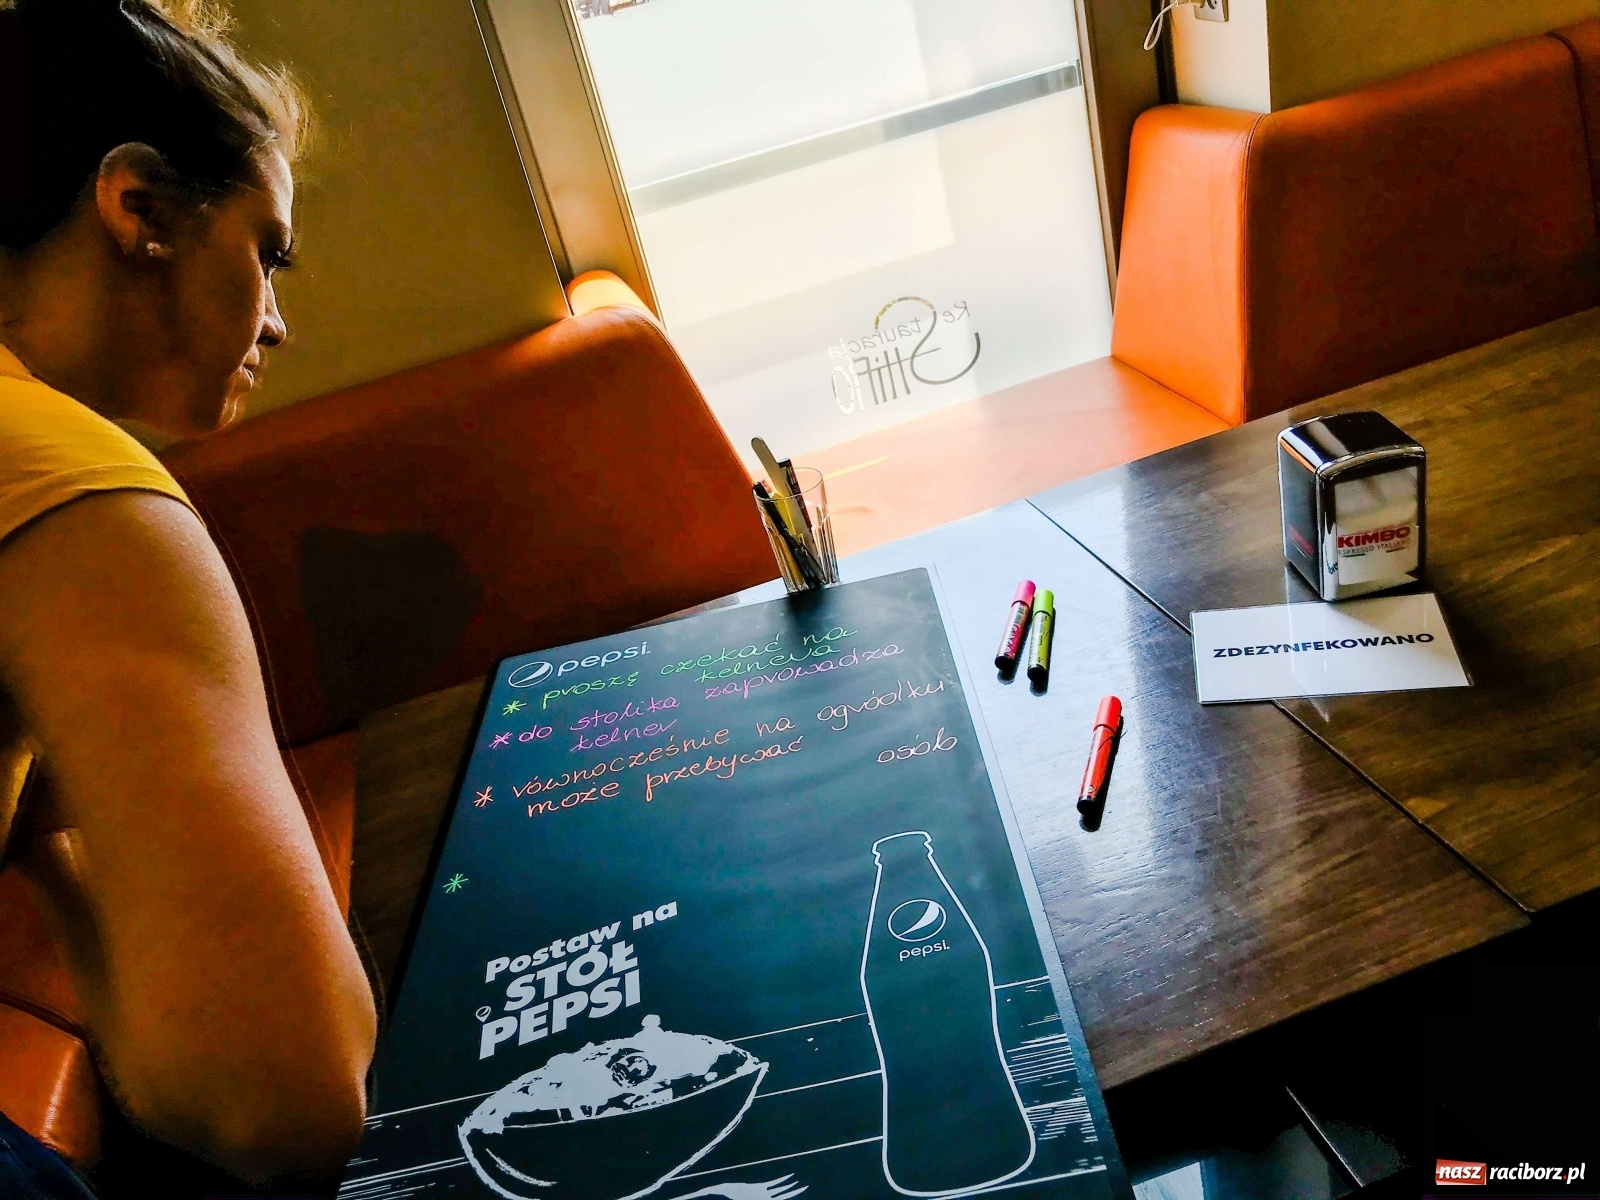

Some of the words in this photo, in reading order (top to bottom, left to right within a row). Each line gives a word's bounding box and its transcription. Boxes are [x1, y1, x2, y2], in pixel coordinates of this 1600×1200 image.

[1337, 526, 1411, 549] KIMBO
[1338, 545, 1375, 556] ESPRESSO
[1377, 538, 1412, 552] ITALIANO
[660, 633, 783, 676] czekać
[803, 627, 859, 646] na
[695, 644, 842, 684] kelnera
[1212, 633, 1435, 659] ZDEZYNFEKOWANO
[518, 724, 553, 743] do
[569, 696, 681, 732] stolika
[756, 717, 796, 738] na
[526, 780, 621, 818] może
[644, 735, 804, 802] przebywać
[876, 727, 959, 764] osób
[484, 920, 622, 984] Postaw
[632, 901, 679, 931] na
[503, 939, 639, 1012] STÓŁ
[479, 968, 642, 1061] PEPSI
